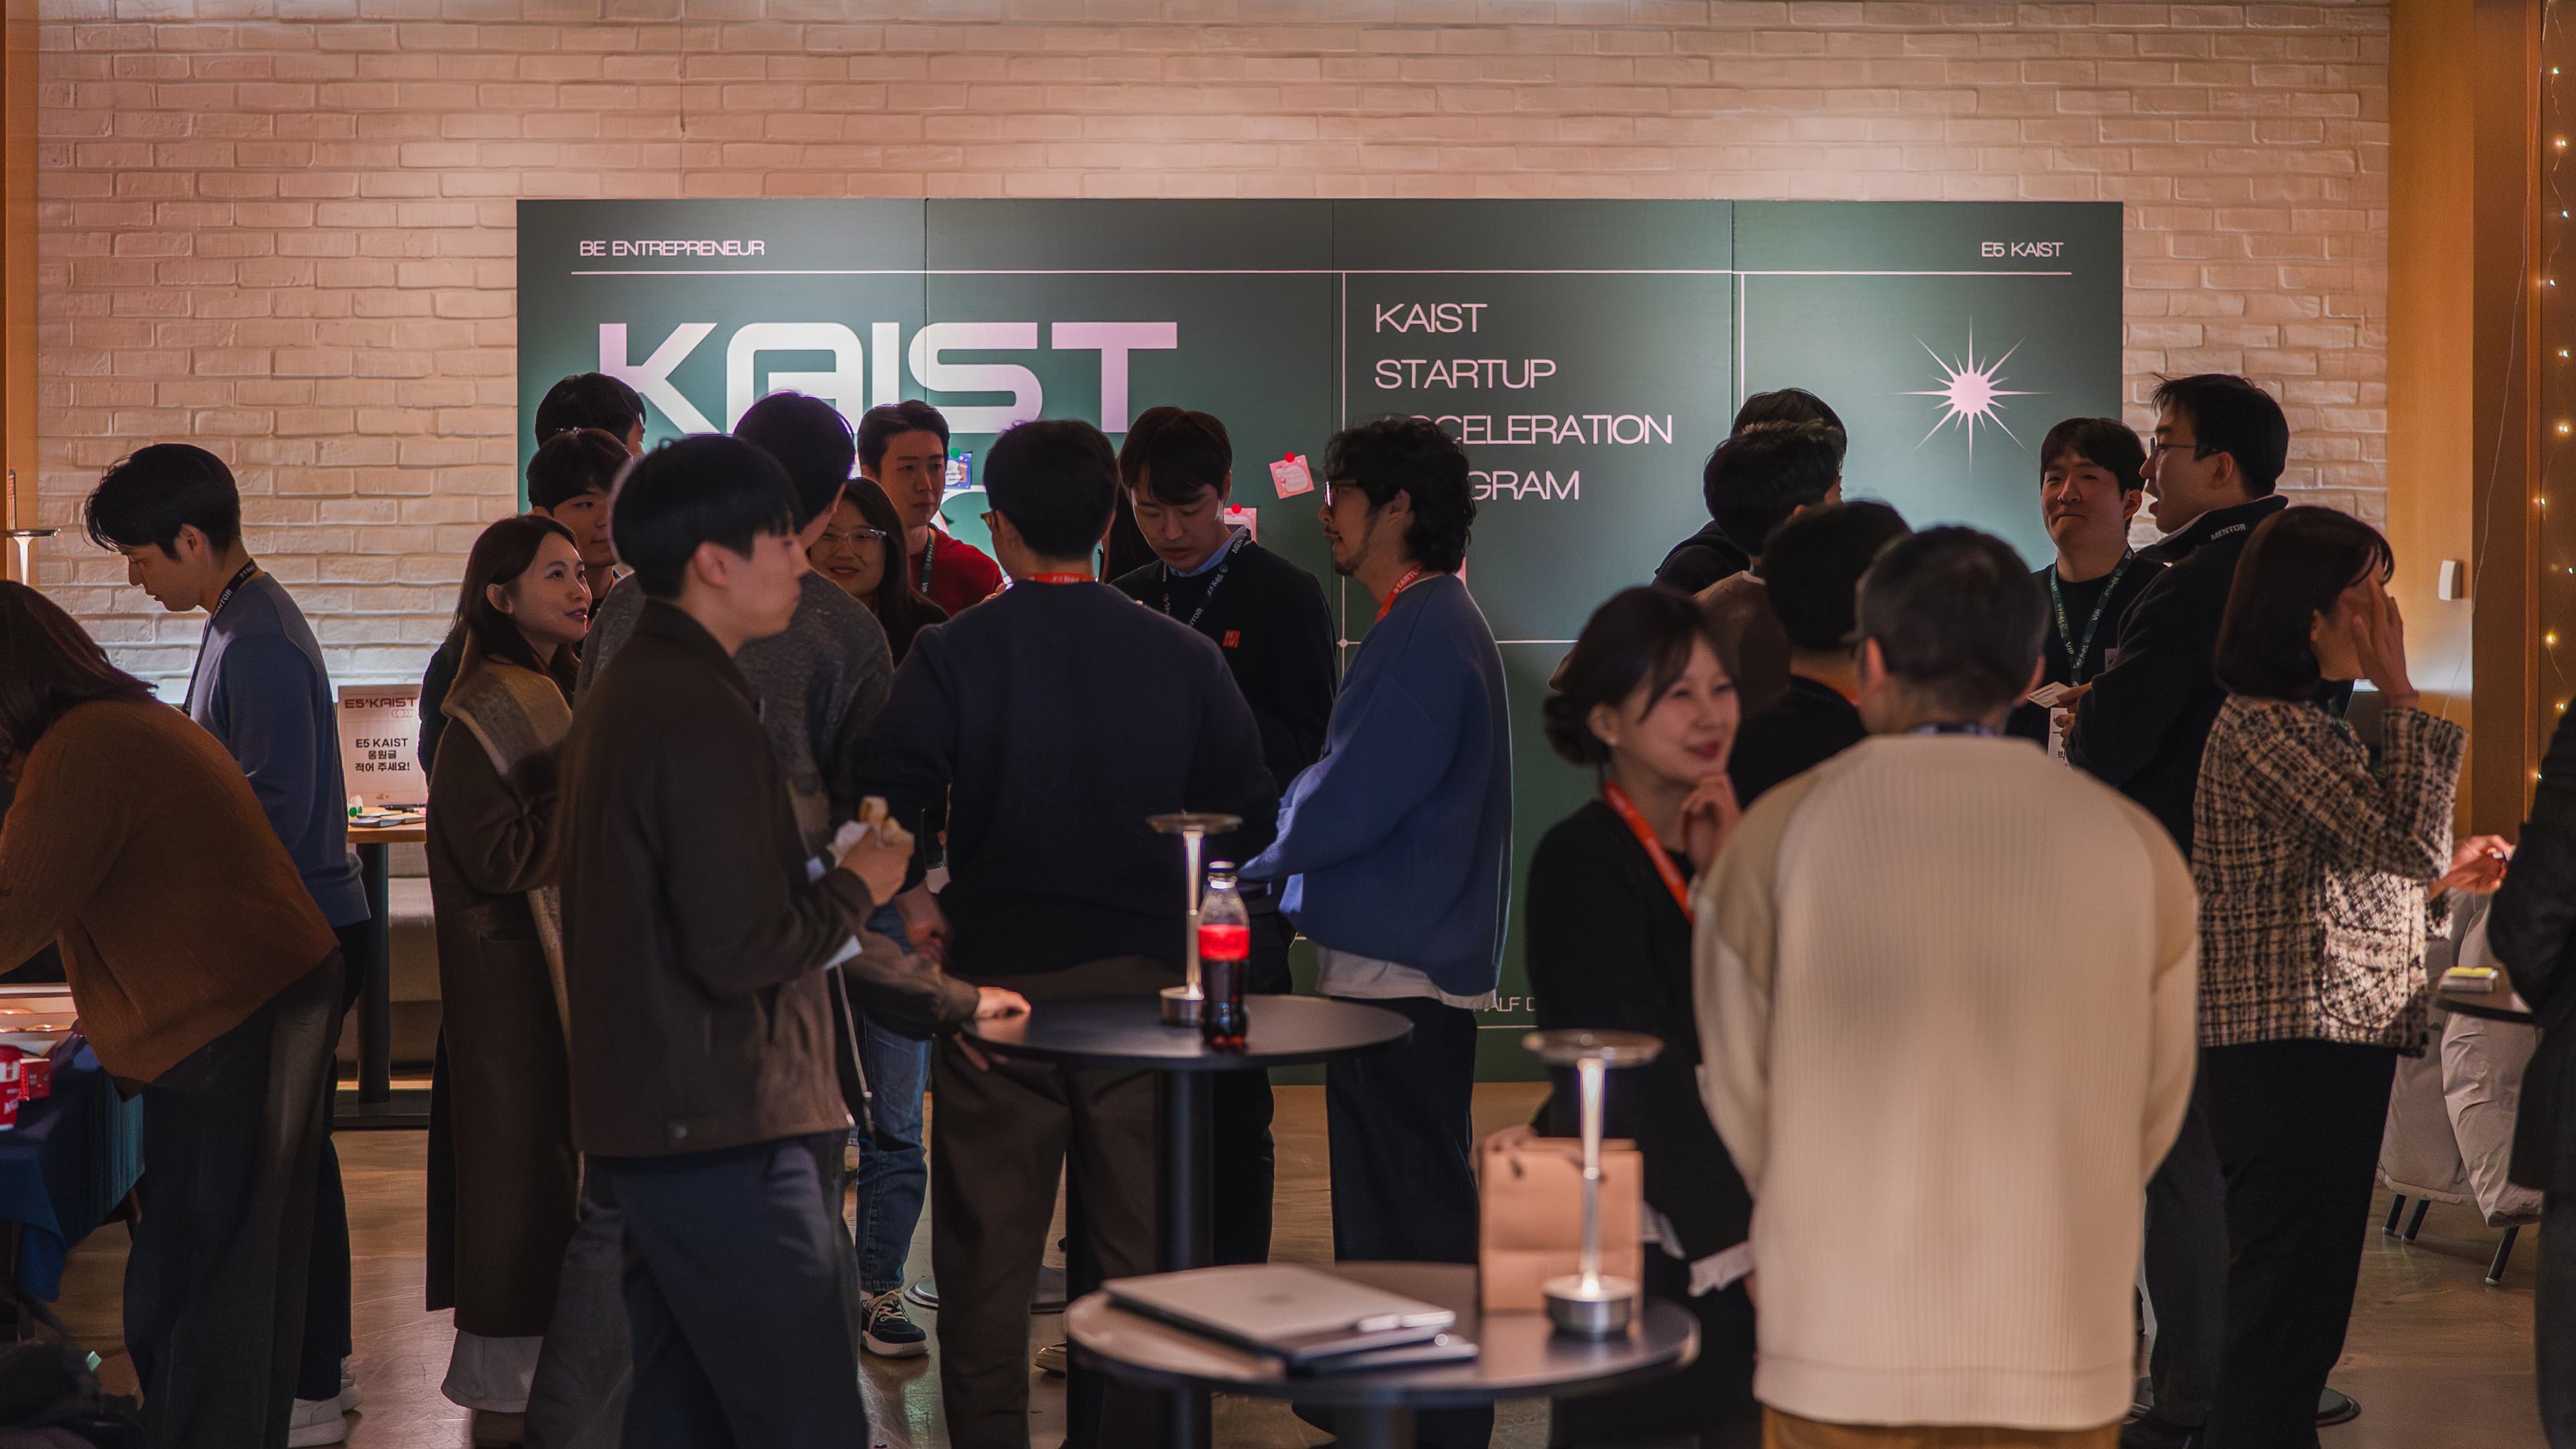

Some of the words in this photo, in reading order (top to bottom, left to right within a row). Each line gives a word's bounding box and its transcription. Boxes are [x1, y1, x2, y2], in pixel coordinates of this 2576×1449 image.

[580, 240, 606, 256] BE
[612, 240, 765, 256] ENTREPRENEUR
[1981, 242, 2004, 258] E5
[2010, 242, 2063, 258] KAIST
[1376, 303, 1487, 333] KAIST
[599, 322, 1178, 434] KAIST
[1375, 359, 1556, 389] STARTUP
[1383, 414, 1673, 445] CELERATION
[1468, 470, 1580, 501] GRAM
[2210, 523, 2246, 541] MENTOR
[356, 739, 370, 748] E5
[373, 738, 409, 747] KAIST
[368, 750, 396, 760] 응원글
[355, 763, 374, 772] 적어
[377, 761, 410, 772] 주세요!
